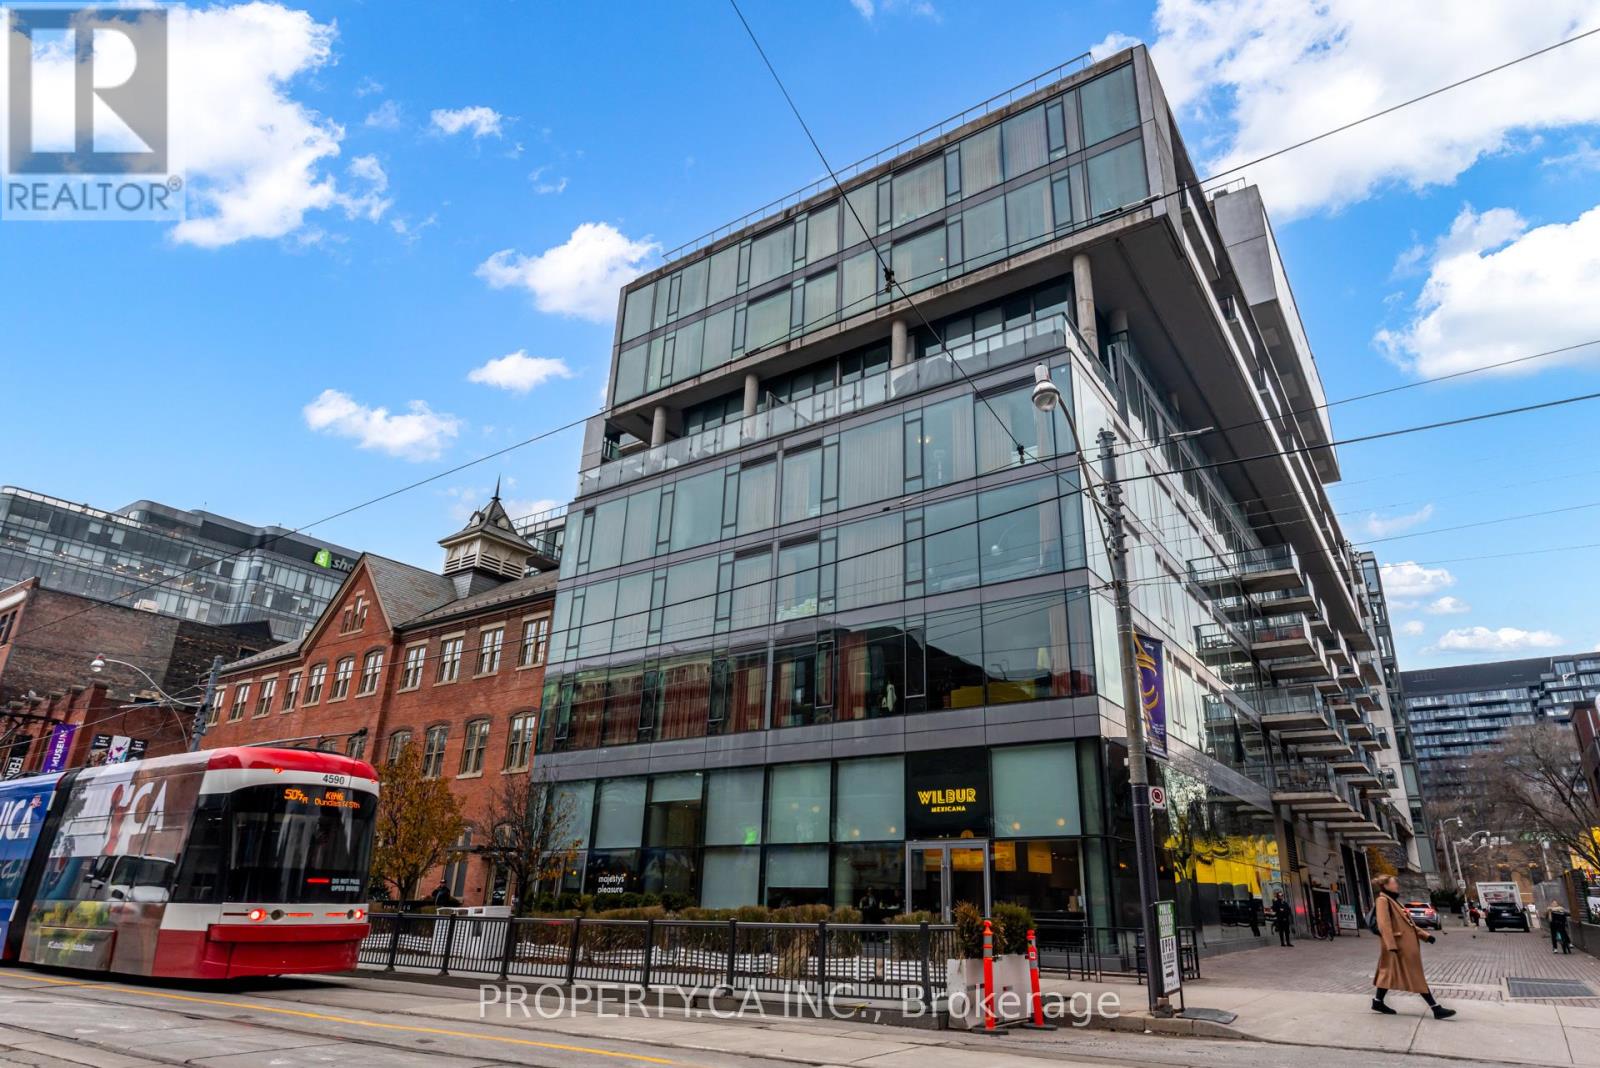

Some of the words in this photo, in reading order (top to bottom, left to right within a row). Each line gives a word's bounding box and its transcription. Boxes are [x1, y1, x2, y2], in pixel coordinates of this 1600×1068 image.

[322, 774, 345, 785] 4590
[917, 788, 976, 805] WILBUR
[931, 805, 966, 813] MEXICANA
